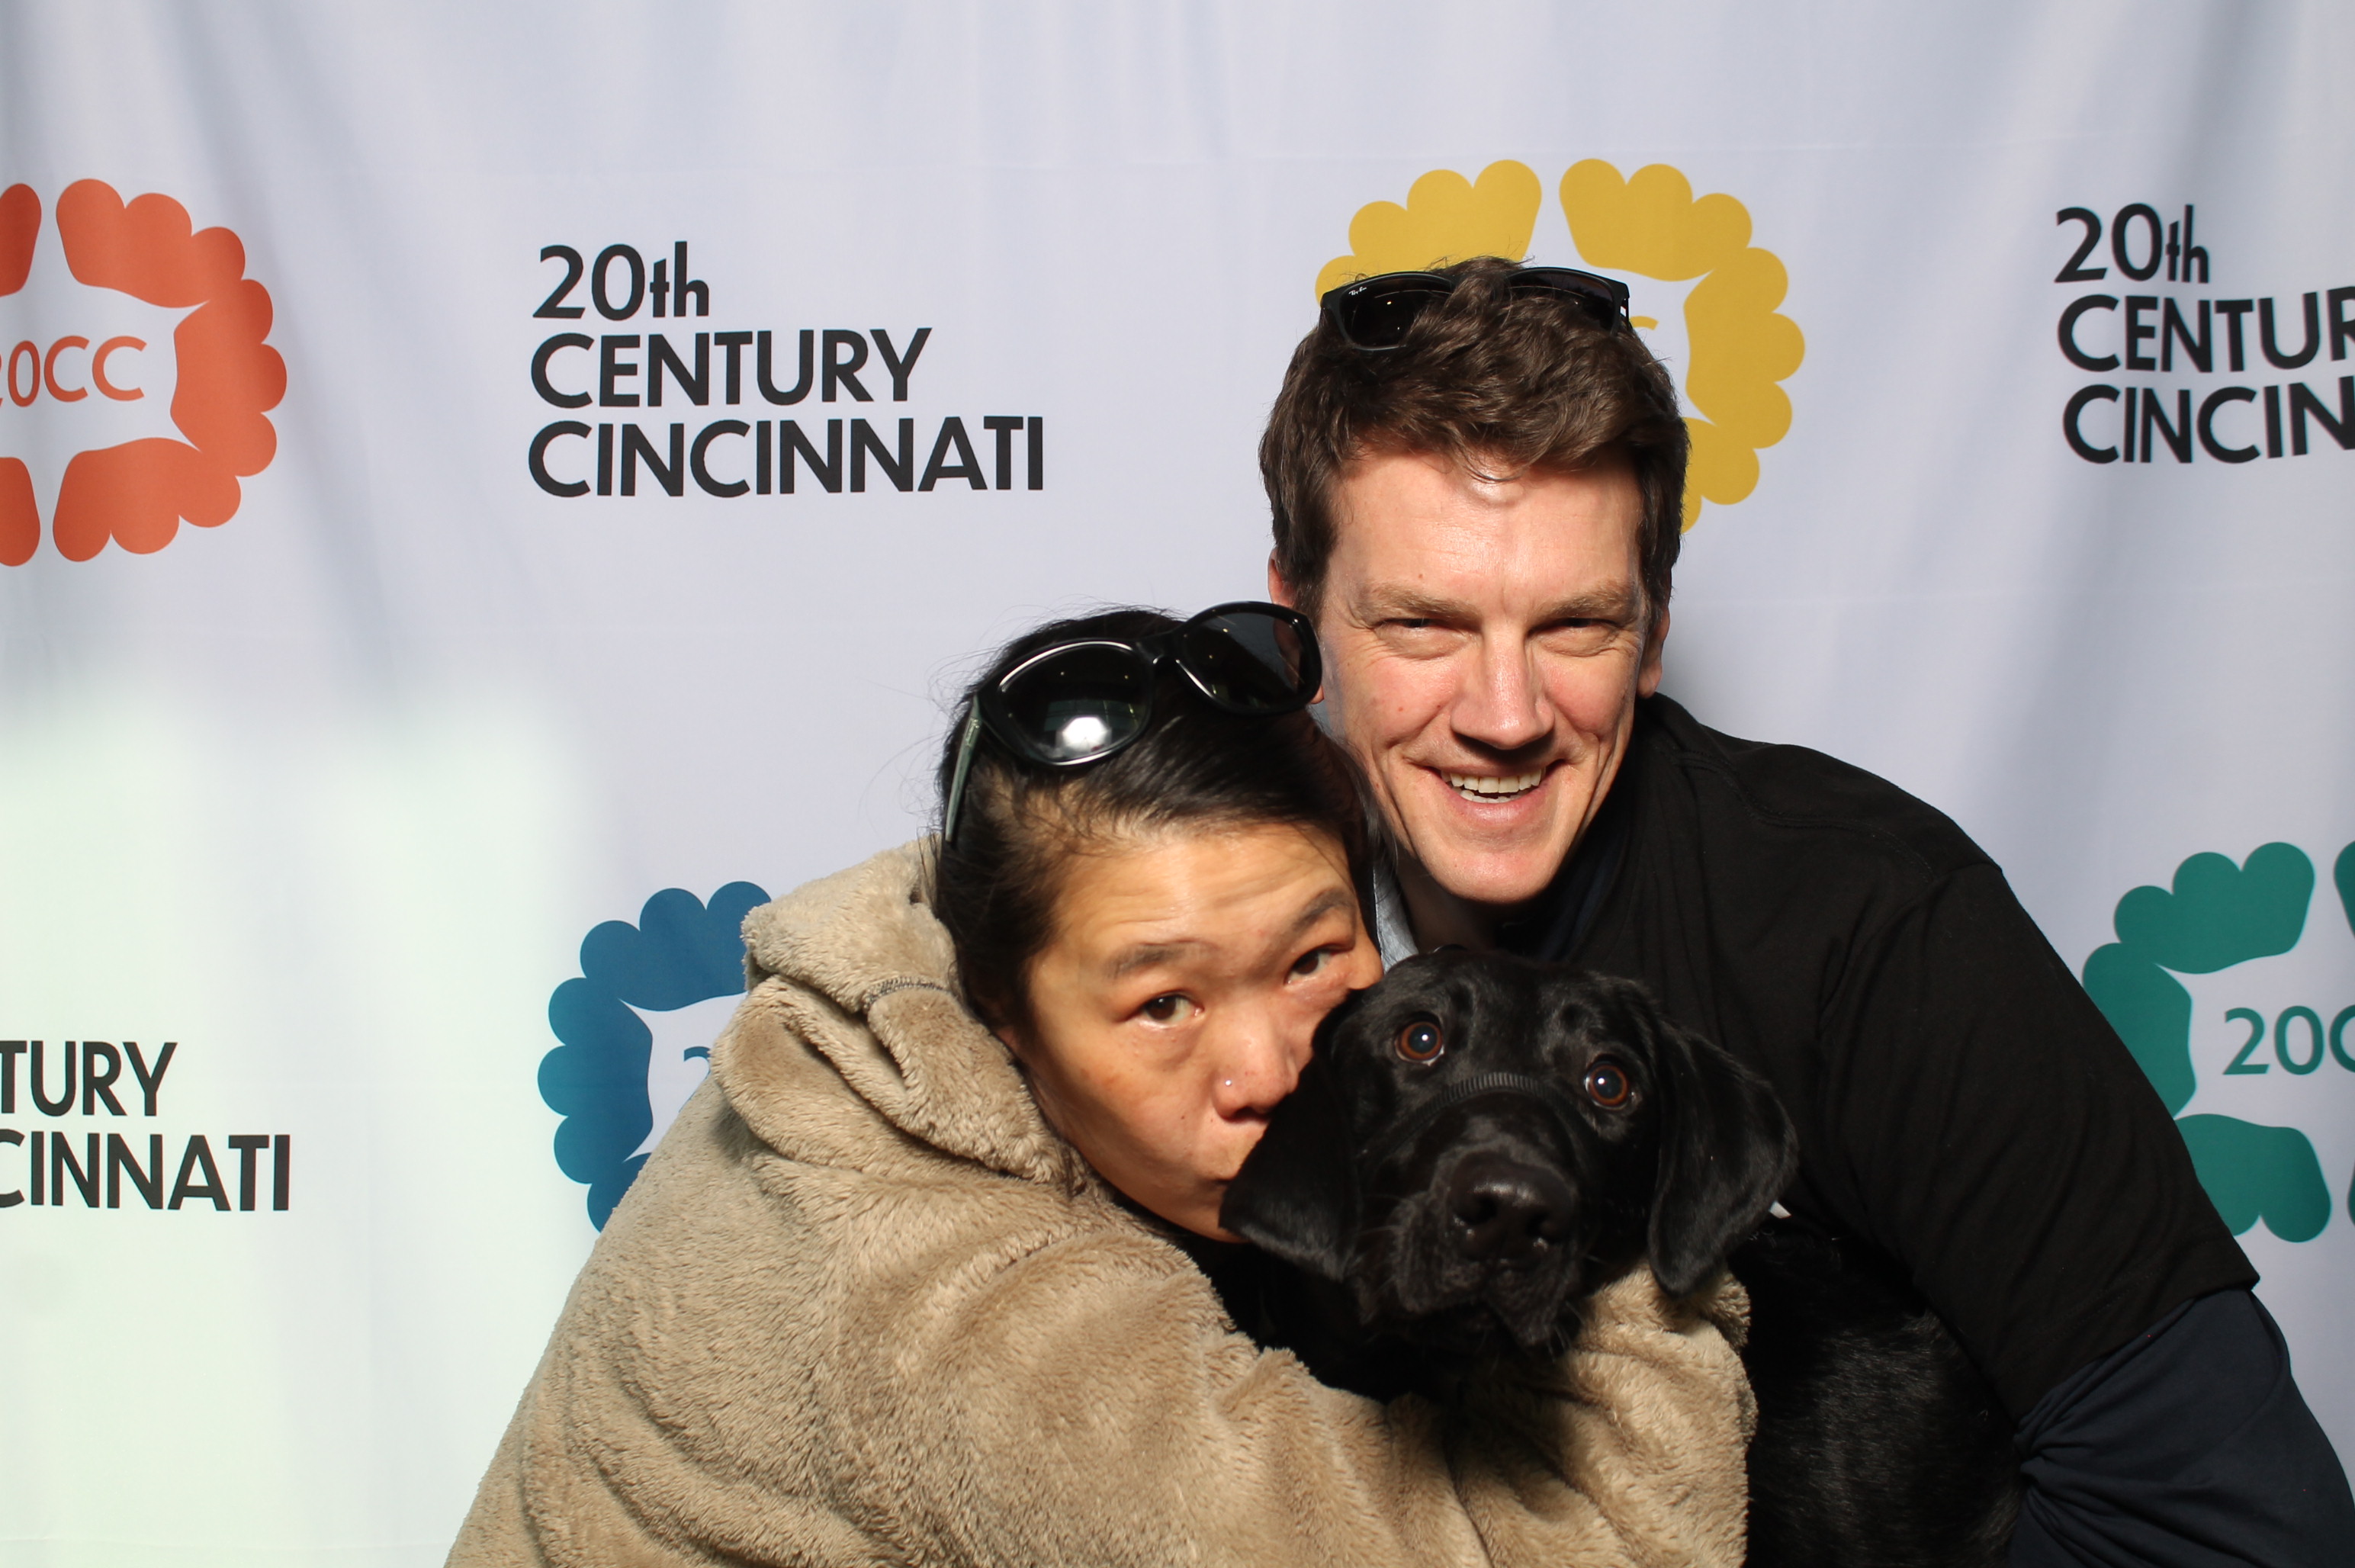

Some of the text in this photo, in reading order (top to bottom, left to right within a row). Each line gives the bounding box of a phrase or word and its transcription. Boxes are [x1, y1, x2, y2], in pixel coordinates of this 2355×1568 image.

[532, 241, 709, 321] 20th
[2055, 203, 2209, 284] 20th
[0, 336, 147, 408] 0CC
[531, 327, 932, 409] CENTURY
[528, 416, 1043, 498] CINCINNATI
[2063, 375, 2355, 464] CINCIN
